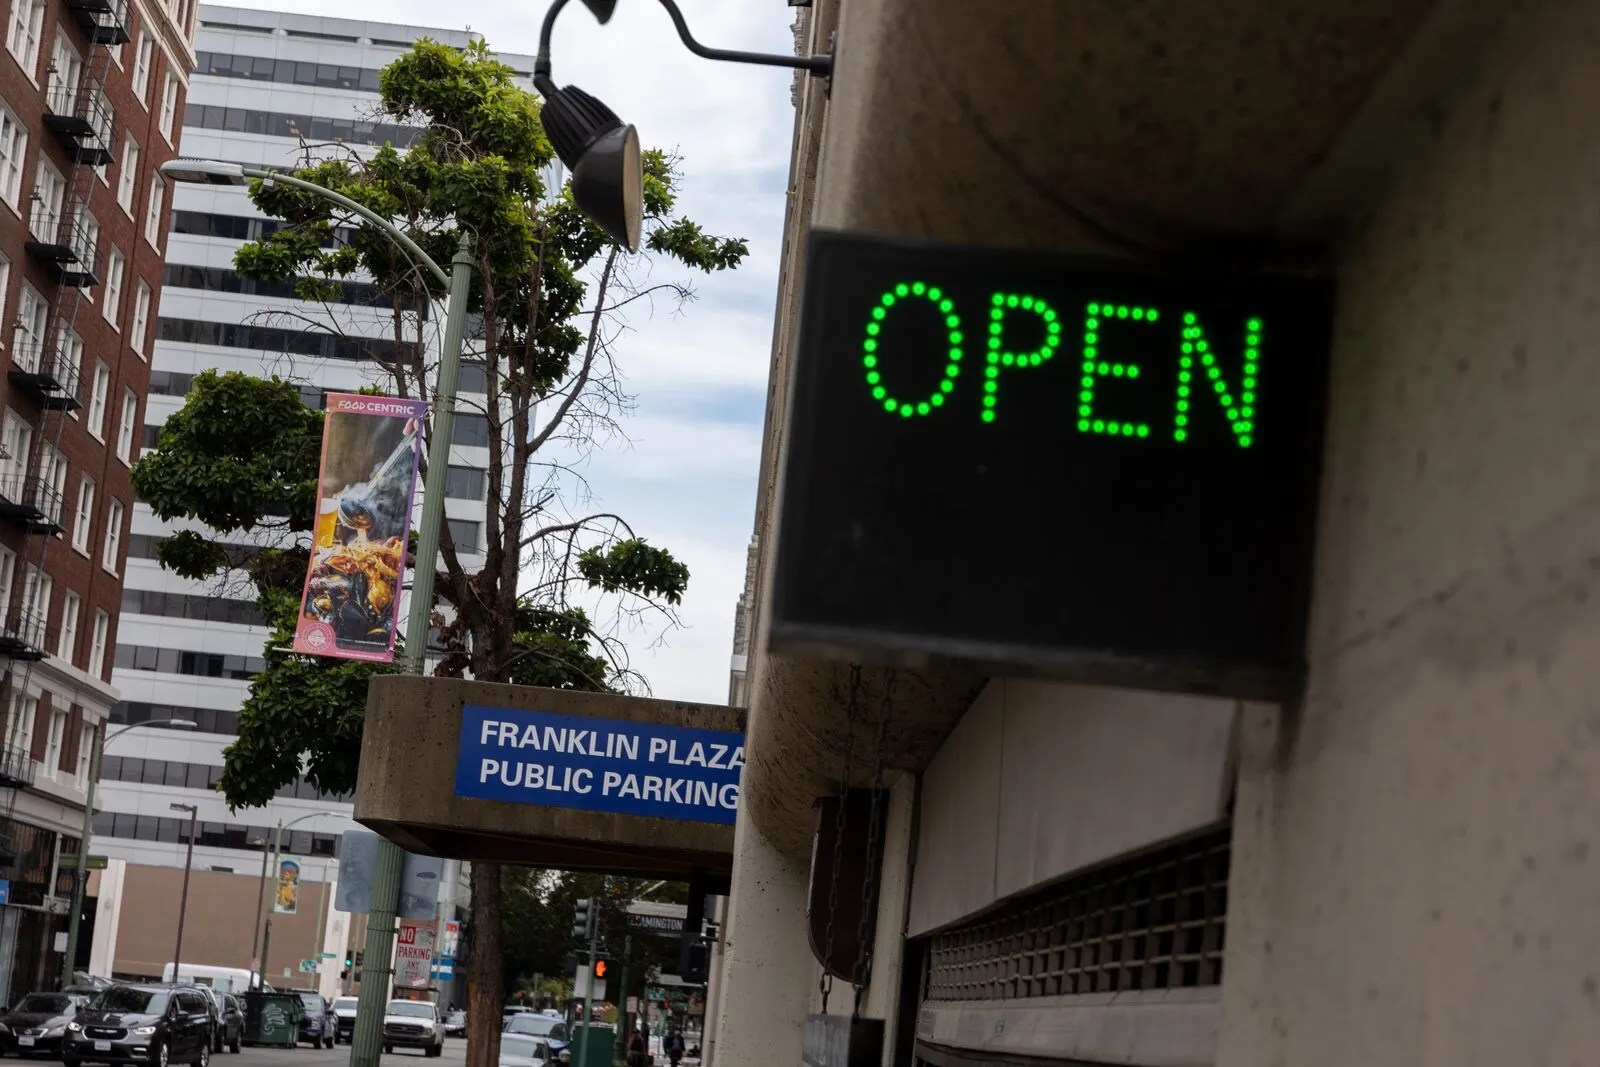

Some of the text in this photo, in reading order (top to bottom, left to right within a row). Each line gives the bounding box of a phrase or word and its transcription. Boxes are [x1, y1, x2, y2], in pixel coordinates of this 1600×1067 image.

[863, 281, 1264, 448] OPEN
[338, 400, 415, 415] FOOD CENTRIC
[480, 719, 744, 770] FRANKLIN PLAZA
[480, 758, 739, 810] PUBLIC PARKING
[630, 915, 683, 931] AMINGTON
[400, 928, 414, 943] NO
[399, 947, 431, 960] PARKING
[407, 960, 419, 970] ANY
